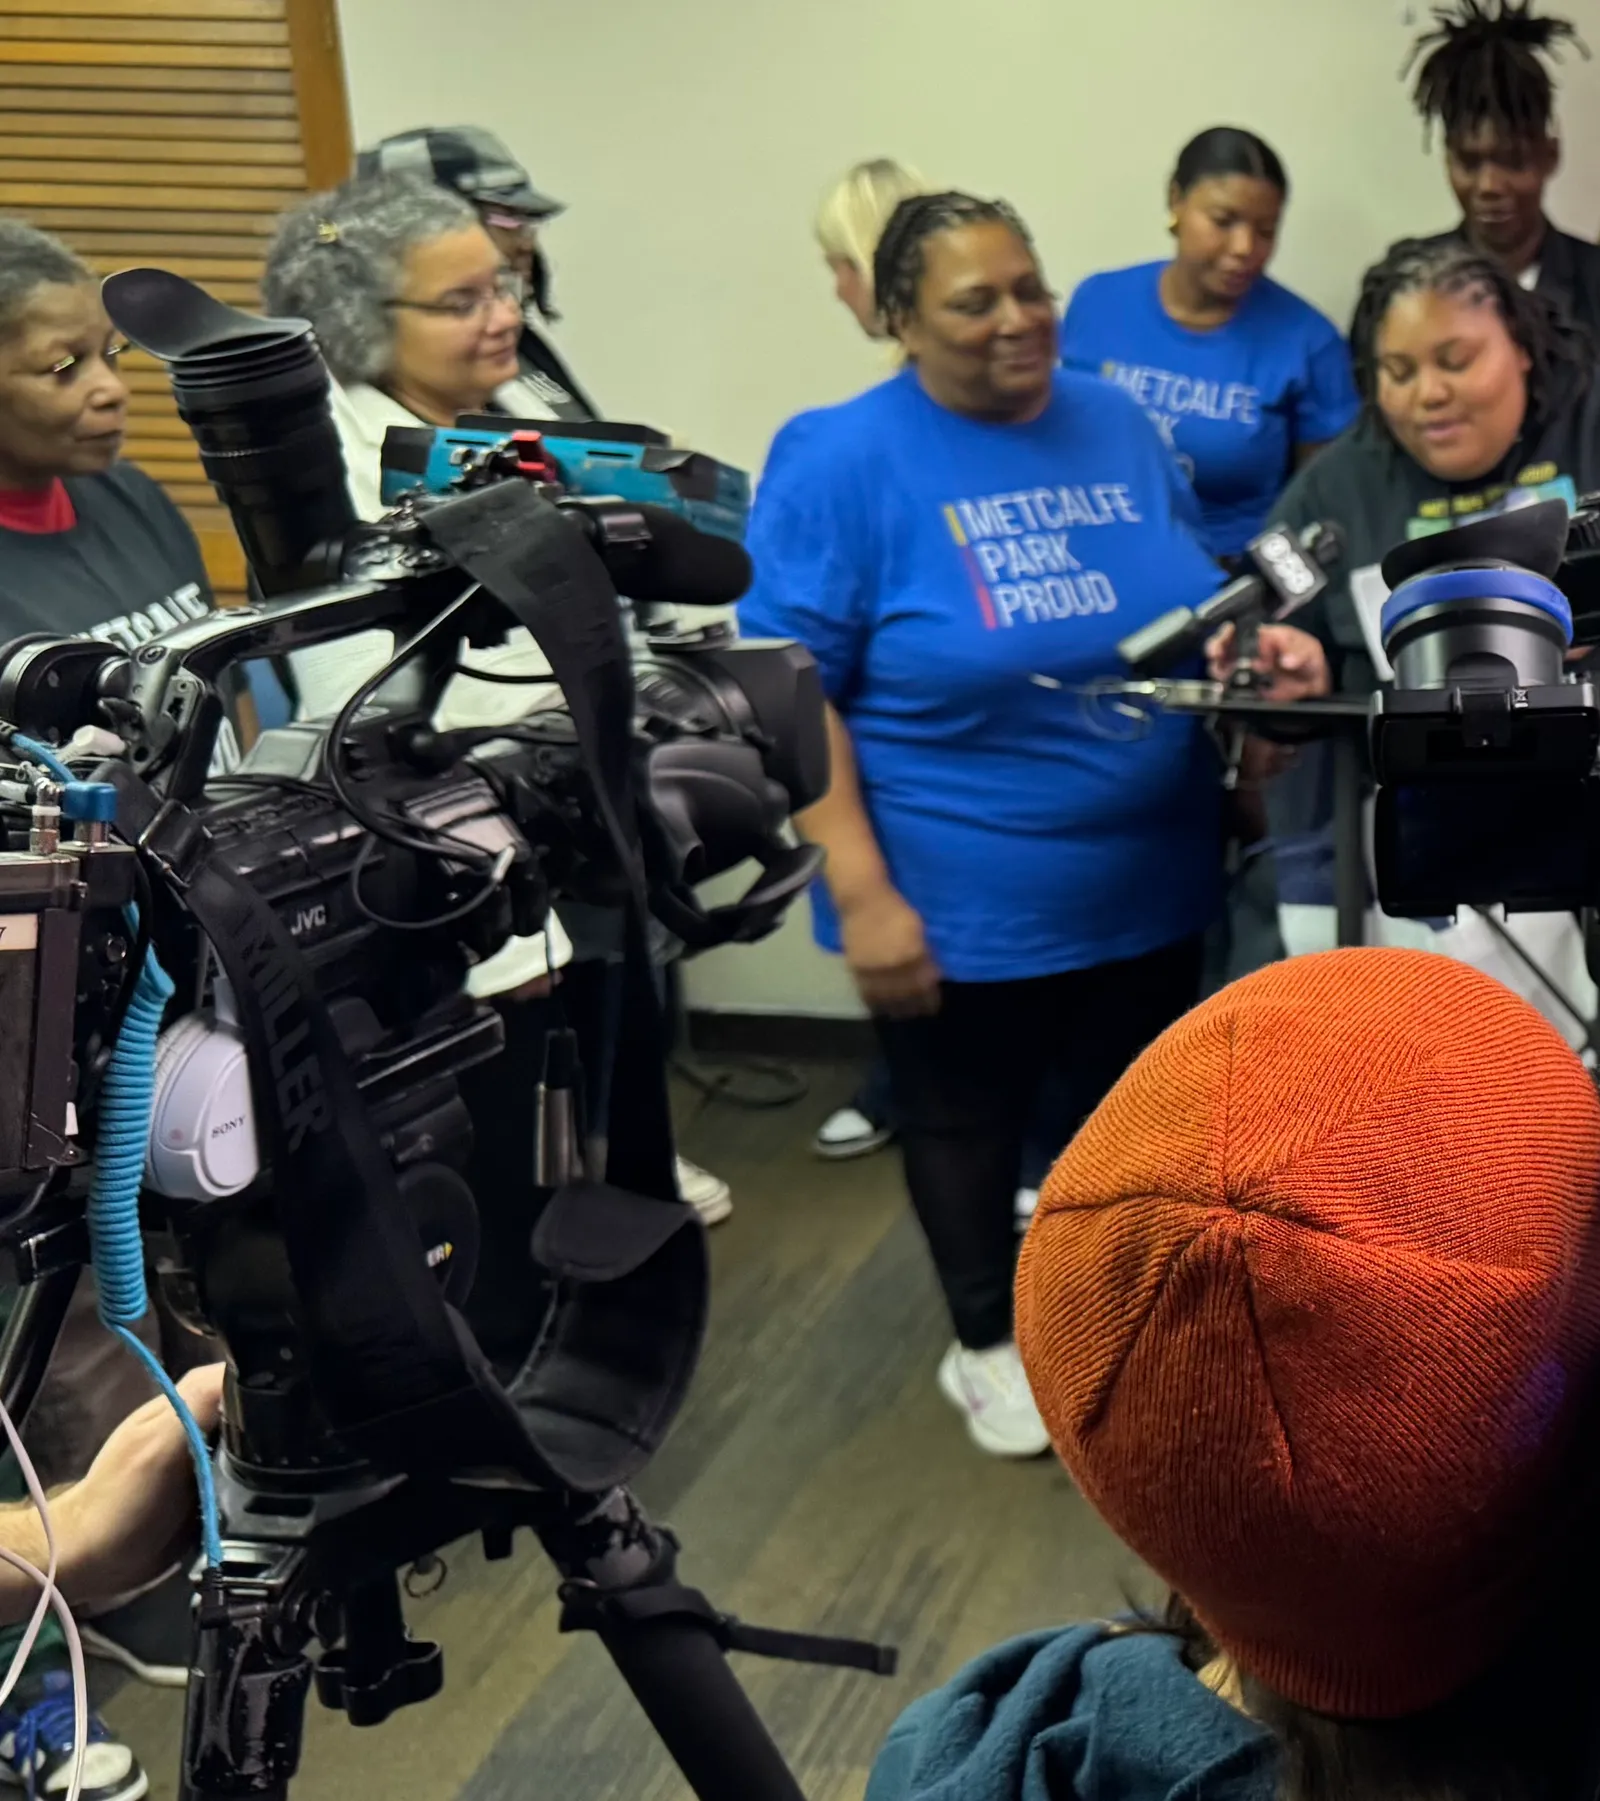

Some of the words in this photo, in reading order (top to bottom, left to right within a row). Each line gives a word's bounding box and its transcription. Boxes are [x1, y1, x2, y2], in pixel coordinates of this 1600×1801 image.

[956, 481, 1144, 541] METCALFE
[974, 530, 1083, 584] PARK
[992, 568, 1118, 628] PROUD
[290, 904, 326, 935] JVC
[211, 1114, 246, 1139] SONY
